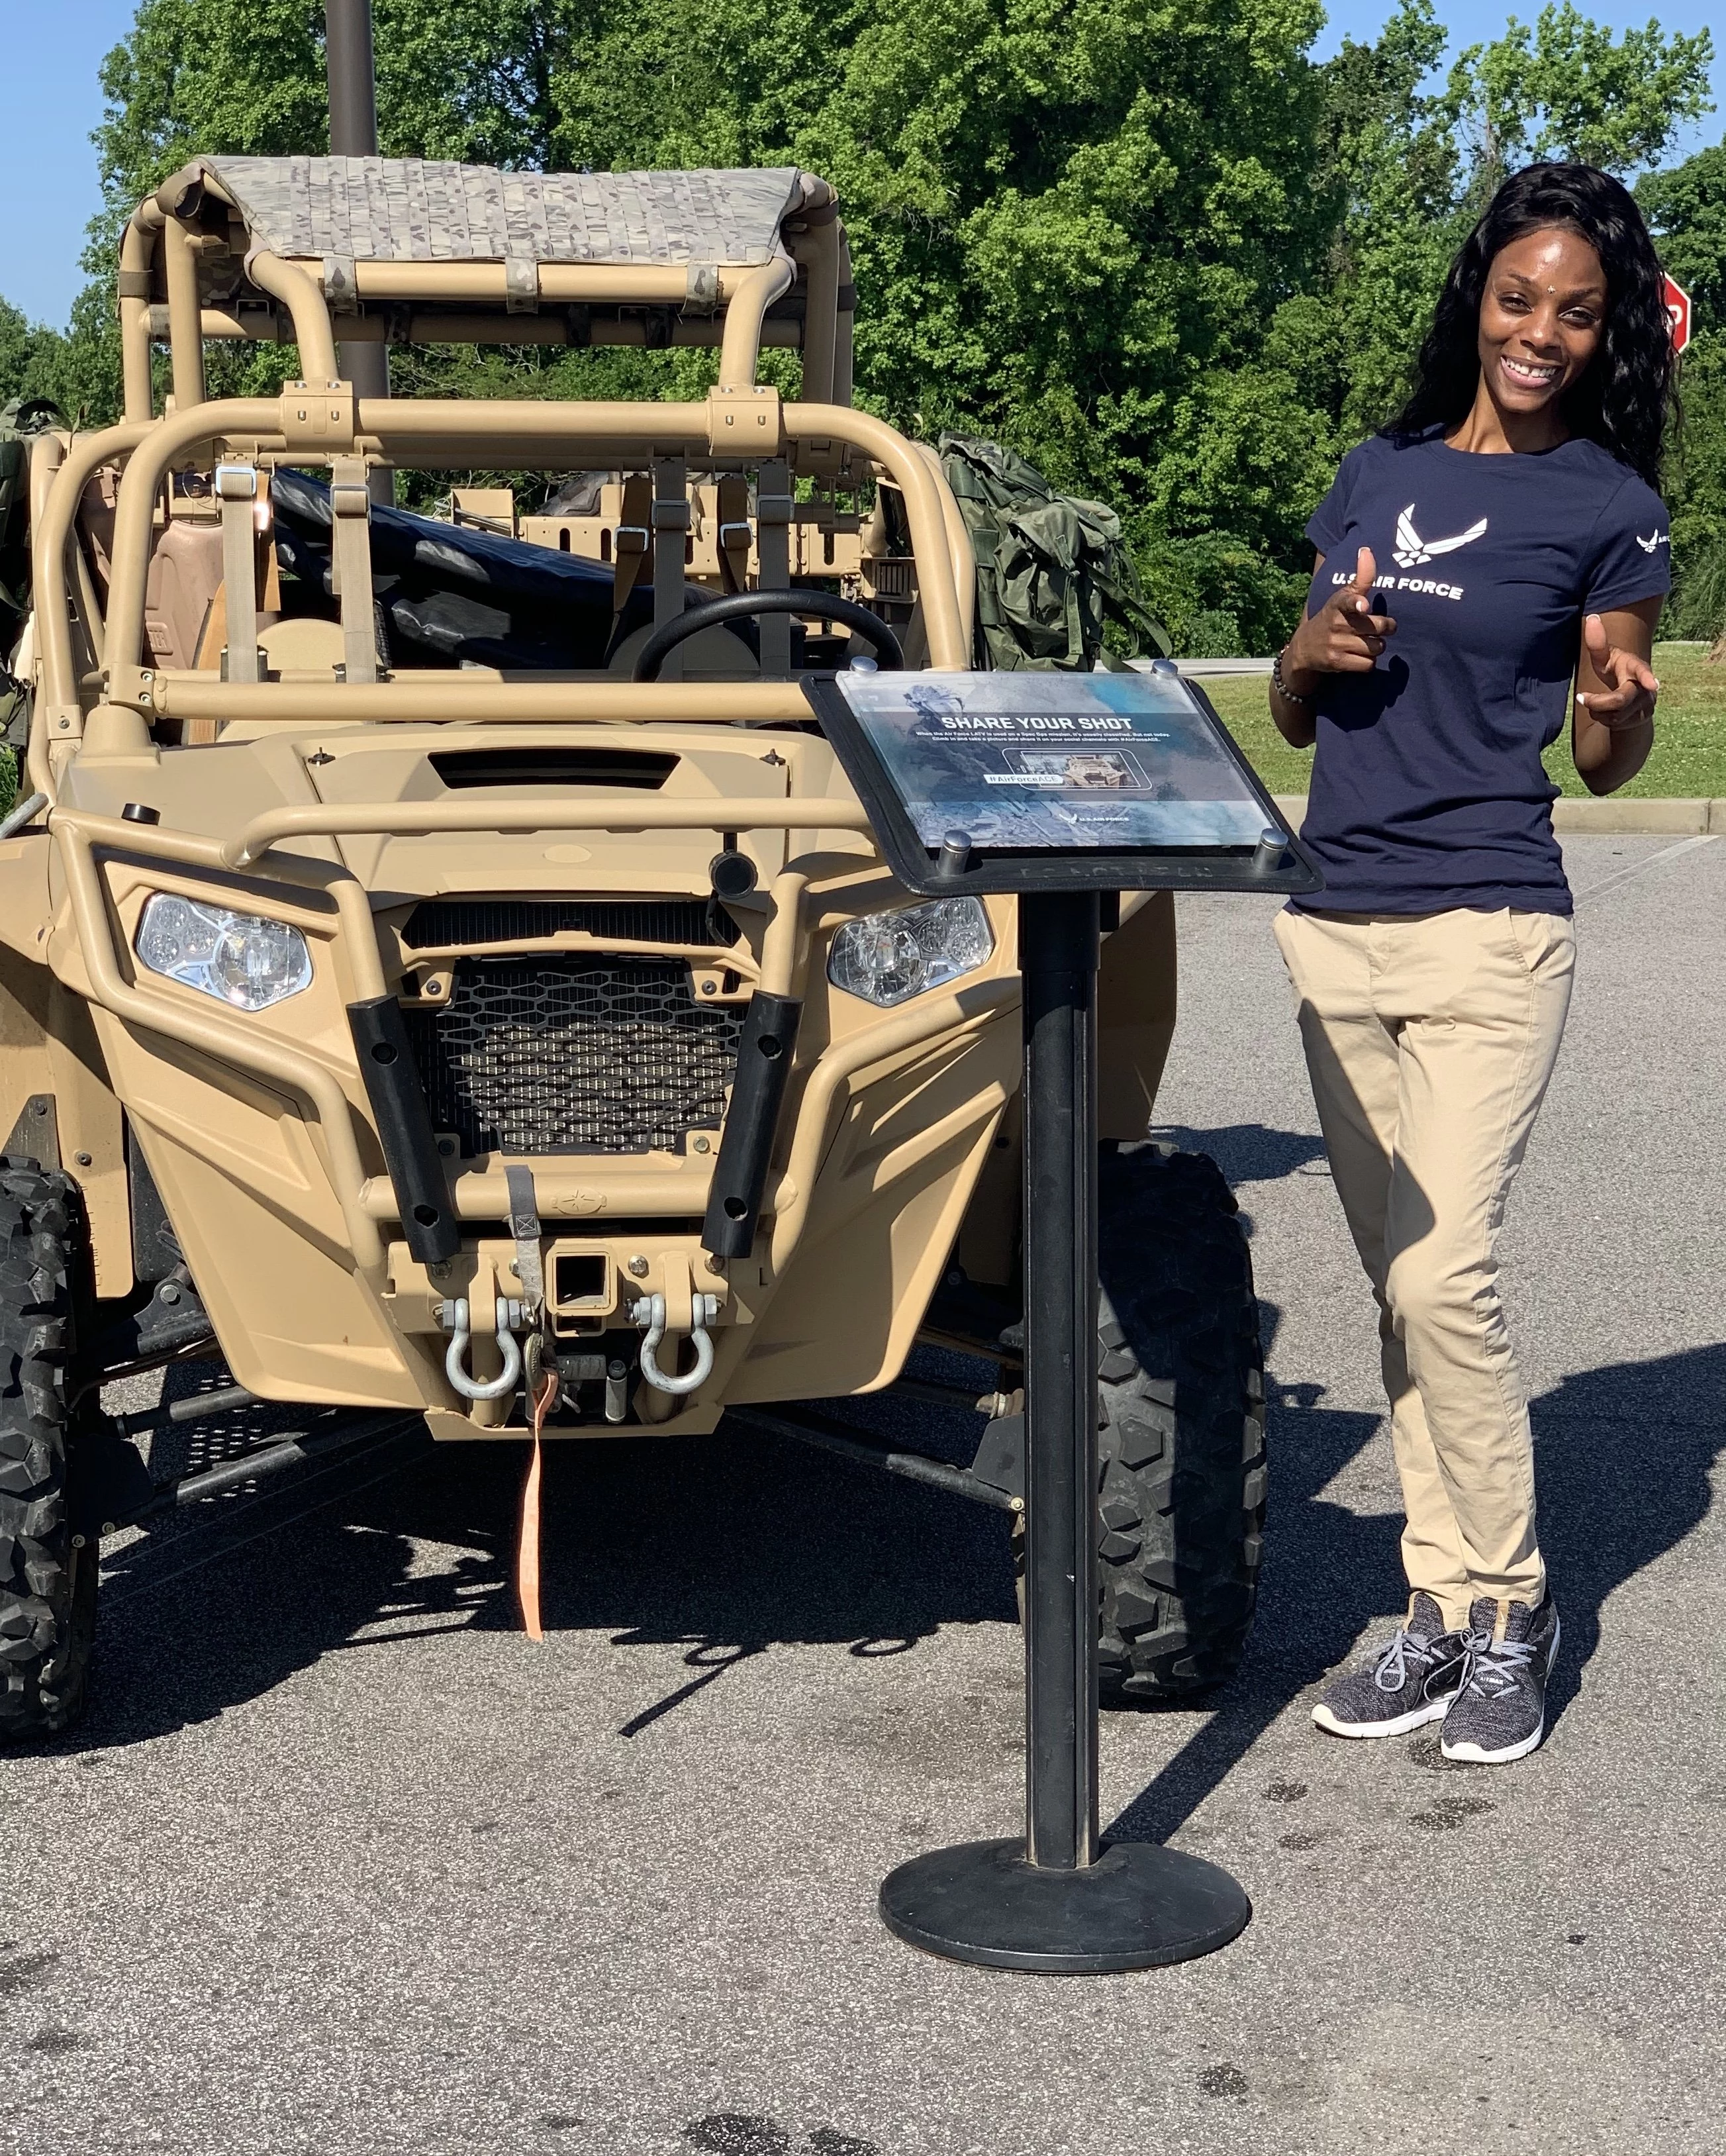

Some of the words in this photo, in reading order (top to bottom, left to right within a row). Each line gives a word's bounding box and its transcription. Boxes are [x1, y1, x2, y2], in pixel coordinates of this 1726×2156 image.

[1397, 577, 1464, 601] FORCE
[941, 717, 1015, 729] SHARE
[1015, 717, 1075, 730] YOUR
[1077, 718, 1132, 730] SHOT
